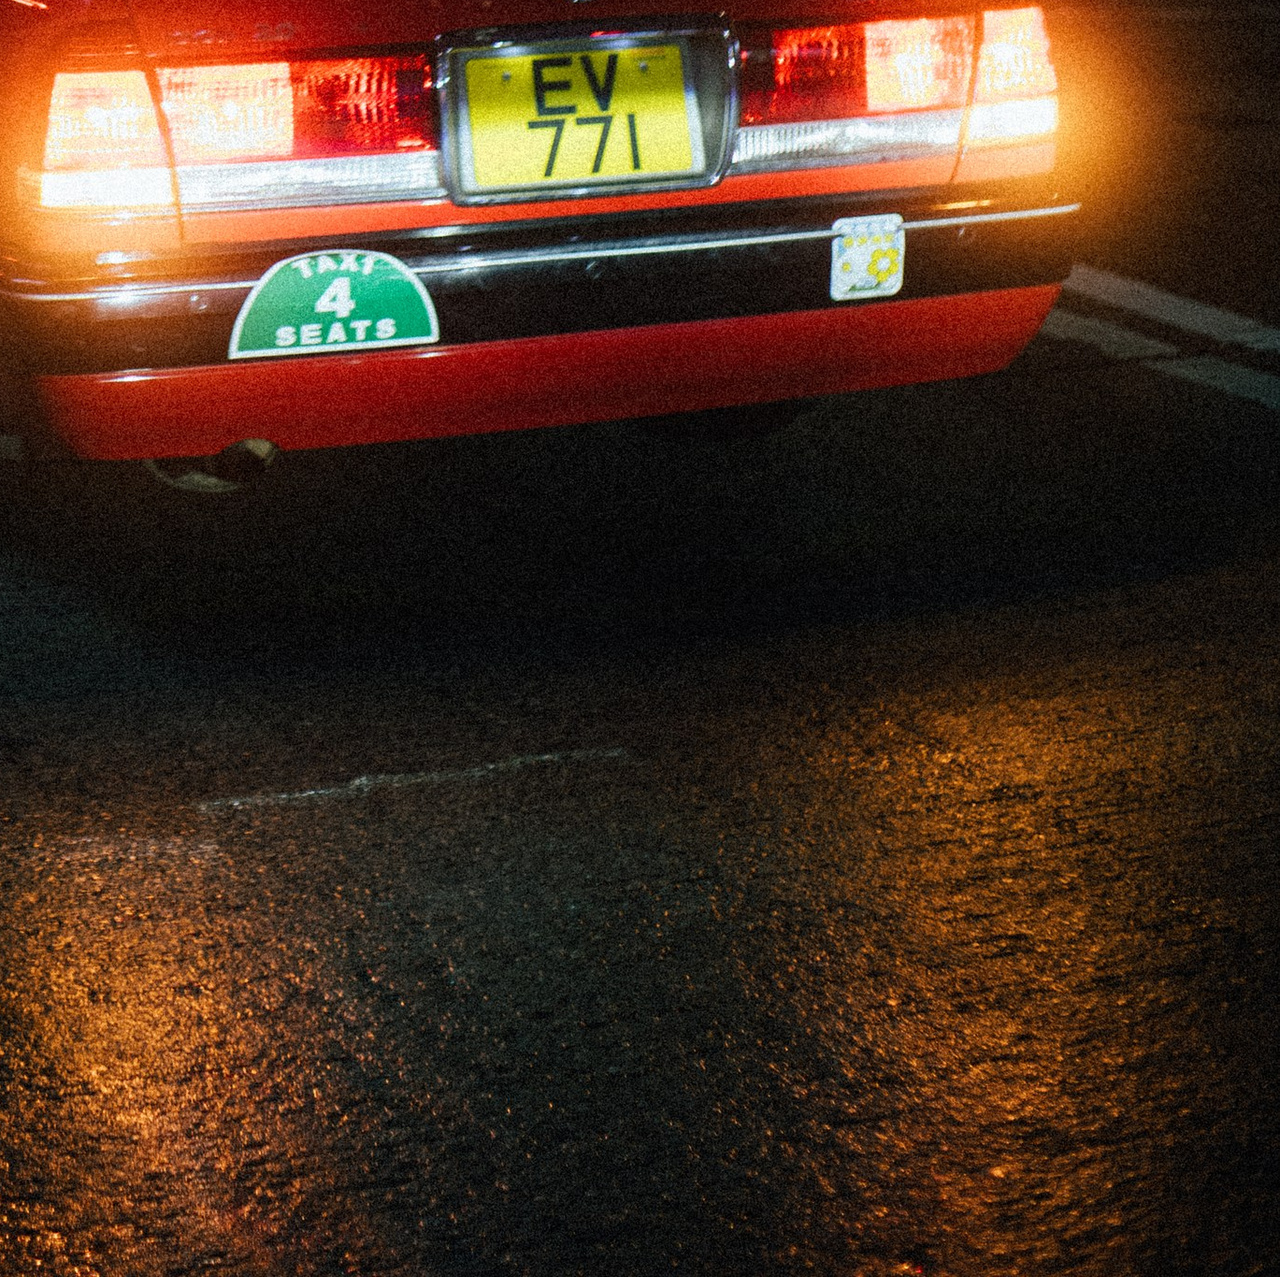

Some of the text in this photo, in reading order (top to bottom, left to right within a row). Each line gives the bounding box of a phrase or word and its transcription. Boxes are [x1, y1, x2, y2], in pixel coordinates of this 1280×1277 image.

[532, 53, 618, 117] EV
[528, 114, 641, 178] 771
[291, 253, 376, 279] TAXI
[314, 276, 356, 319] 4
[274, 317, 397, 347] SEATS
